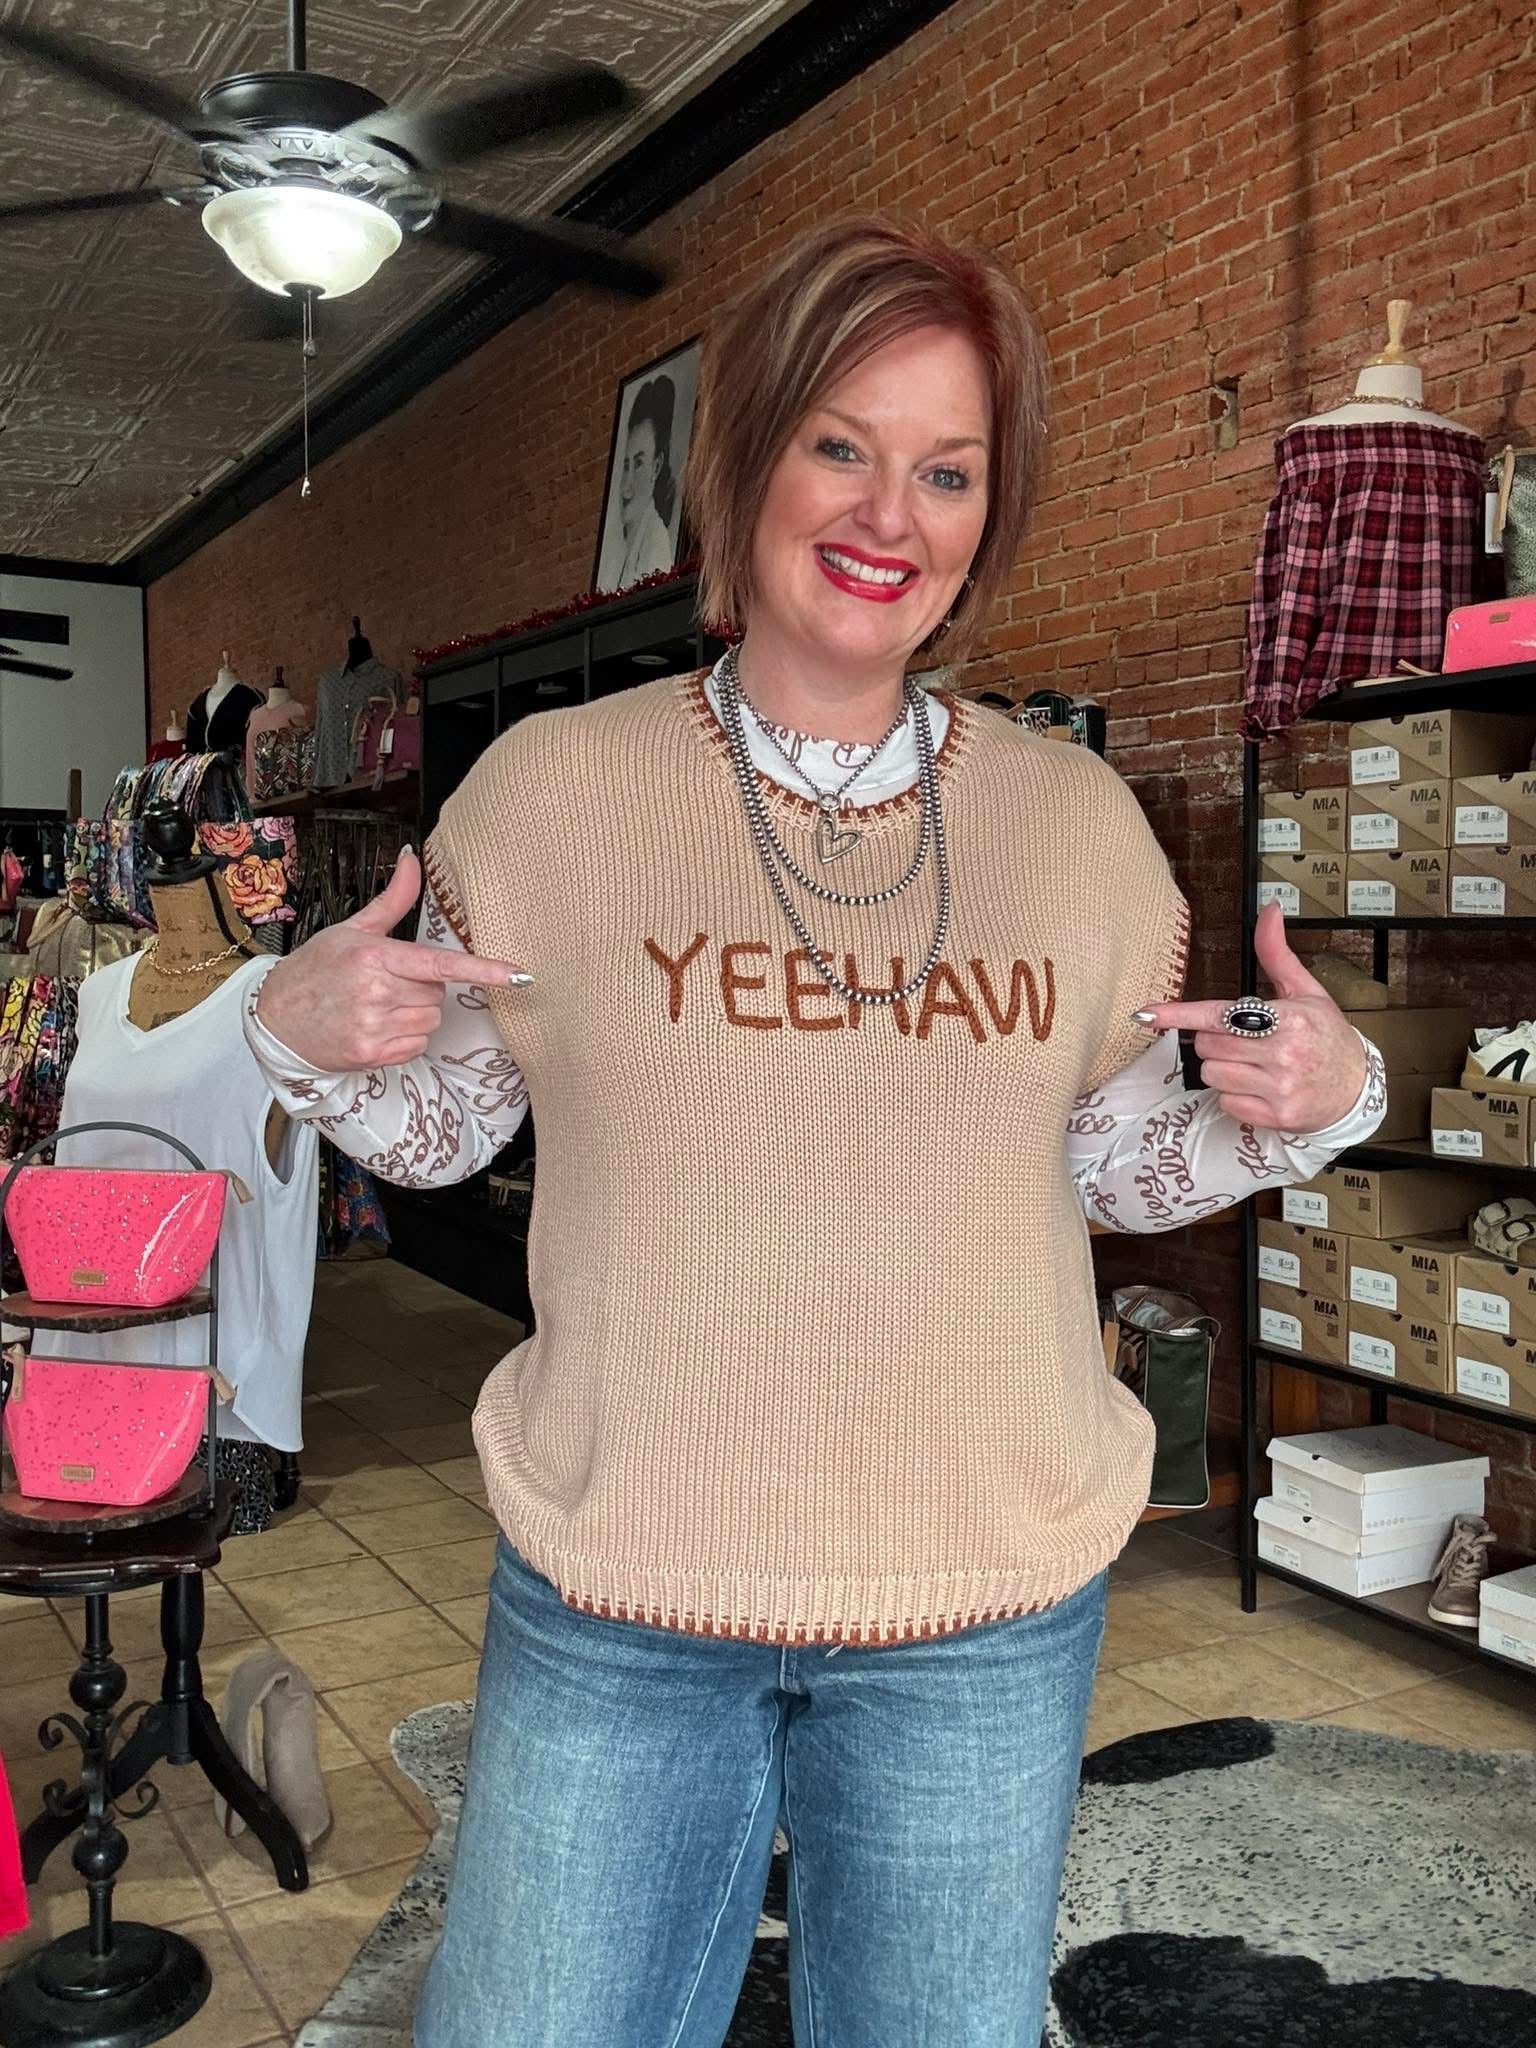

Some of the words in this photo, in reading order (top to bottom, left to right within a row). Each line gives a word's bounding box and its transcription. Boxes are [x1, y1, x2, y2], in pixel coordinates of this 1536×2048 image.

[1411, 719, 1443, 736] MIA
[1409, 787, 1441, 803] MIA
[1312, 797, 1340, 811] MIA
[1311, 862, 1340, 875] MIA
[1409, 858, 1441, 873] MIA
[643, 932, 1056, 1043] YEEHAW
[1488, 1098, 1519, 1116] MIA
[1343, 1175, 1371, 1190] MIA
[1312, 1236, 1338, 1252] MIA
[1411, 1255, 1440, 1272] MIA
[1313, 1300, 1339, 1317] MIA
[1410, 1325, 1438, 1342] MIA
